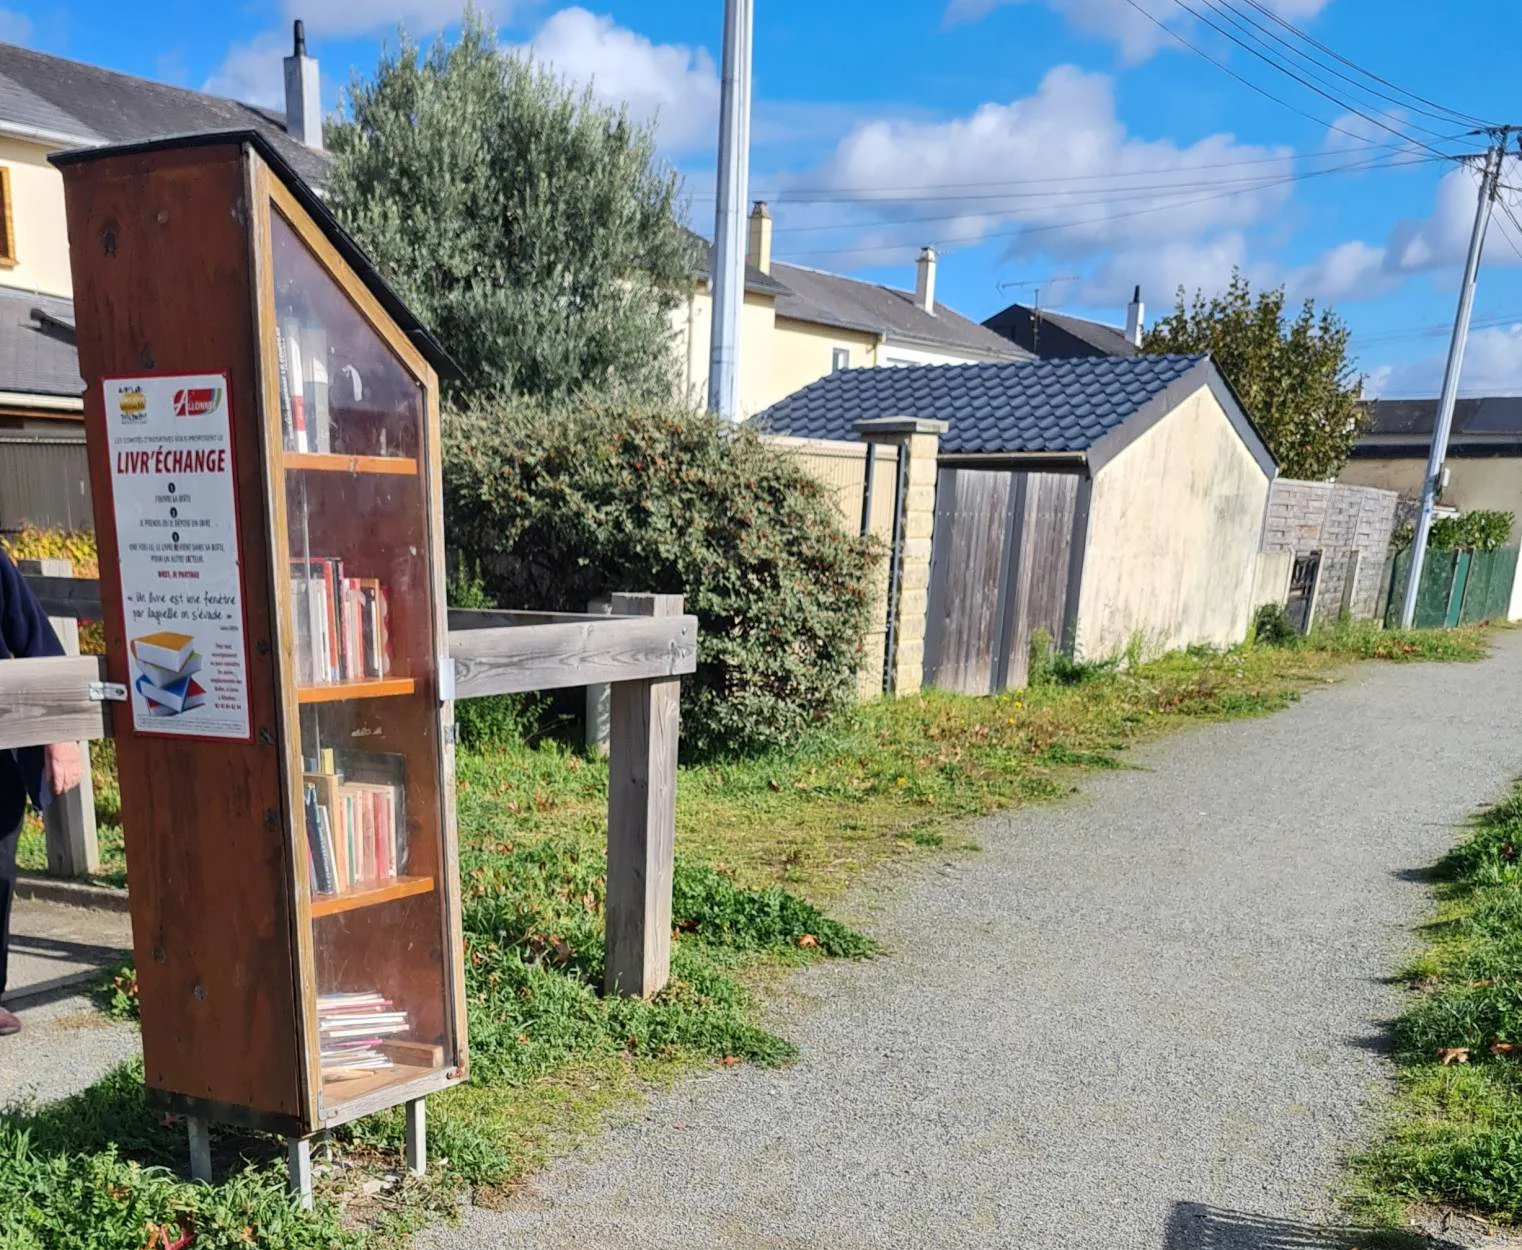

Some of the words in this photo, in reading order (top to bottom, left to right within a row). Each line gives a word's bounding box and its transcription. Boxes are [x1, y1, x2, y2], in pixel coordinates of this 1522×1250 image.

[117, 445, 226, 474] LIVR'ÉCHANGE
[149, 592, 166, 603] livre
[170, 594, 183, 605] est
[148, 608, 178, 624] laquelle
